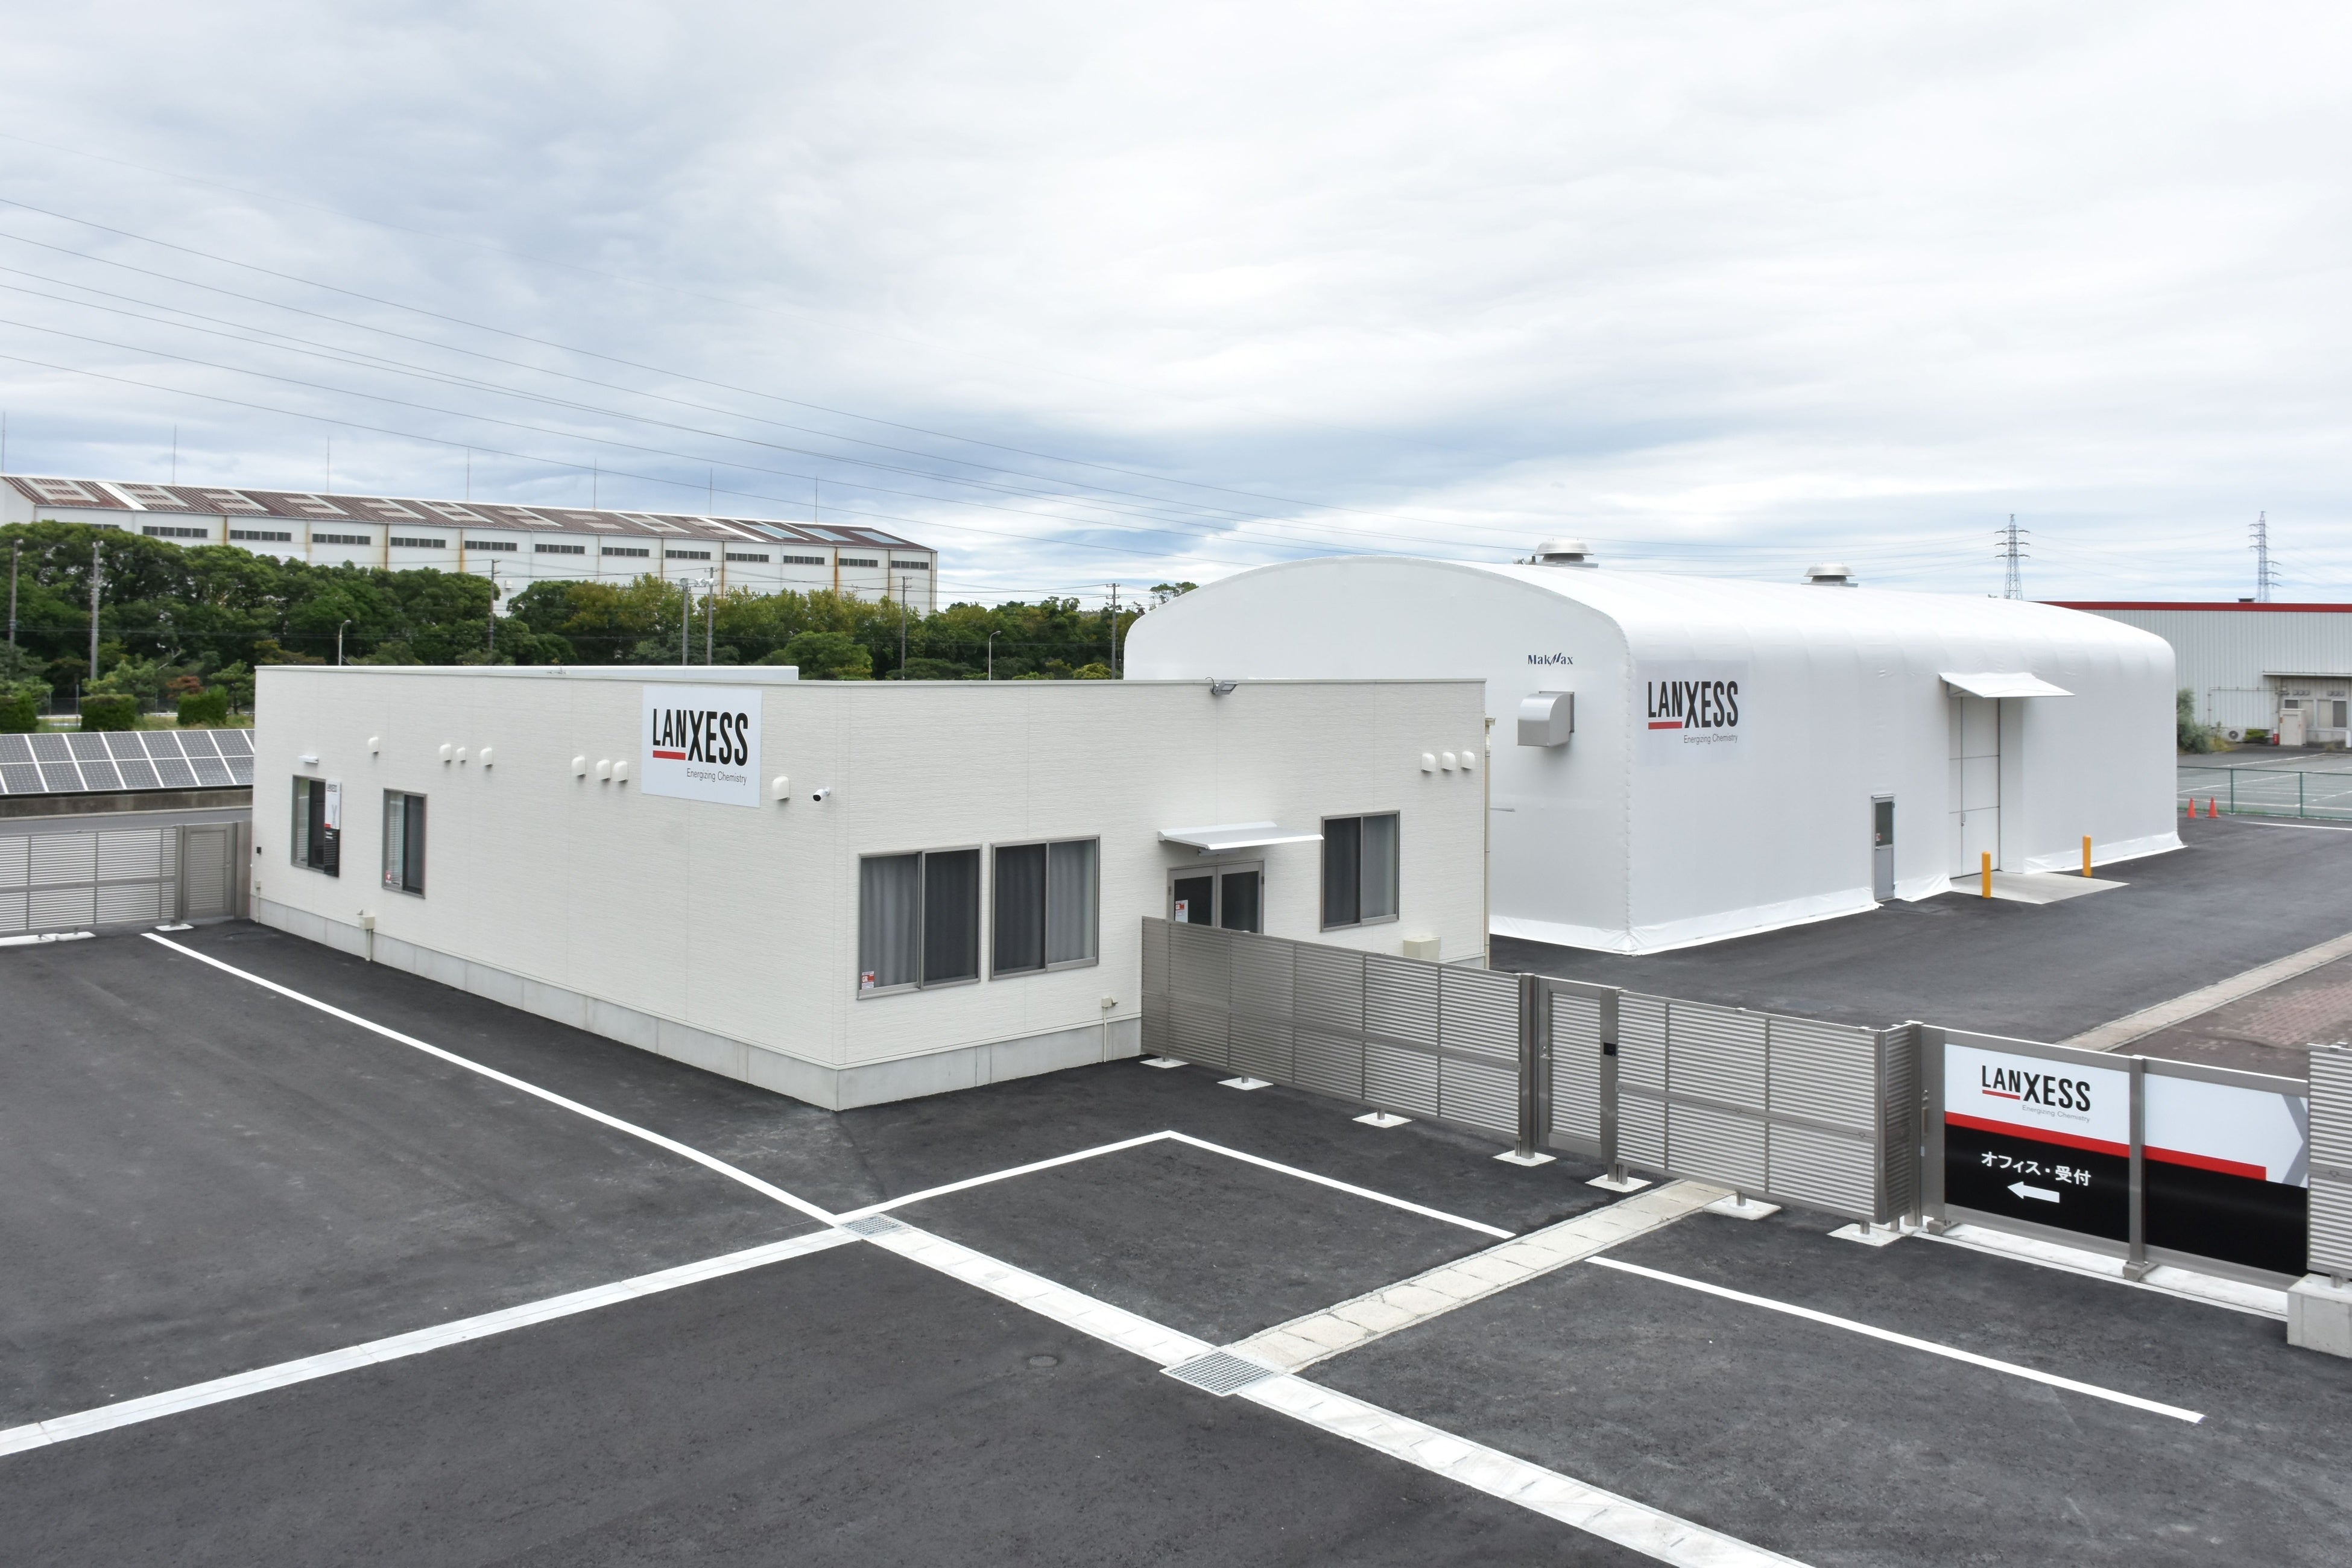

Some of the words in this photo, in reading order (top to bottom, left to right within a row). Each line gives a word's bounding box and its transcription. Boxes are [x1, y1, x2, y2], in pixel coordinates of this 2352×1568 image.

[1528, 652, 1573, 666] MakMax
[1648, 680, 1739, 729] LANXESS
[652, 708, 748, 767] LANXESS
[1683, 734, 1711, 745] Energizing
[1712, 733, 1738, 743] Chemistry
[686, 768, 716, 782] Energizing
[717, 771, 747, 786] Chemistry
[1982, 1065, 2091, 1112] LANXESS
[2022, 1104, 2055, 1118] Energizing
[2056, 1111, 2090, 1123] Chemistry
[1981, 1151, 2092, 1186] オフィス・受付
